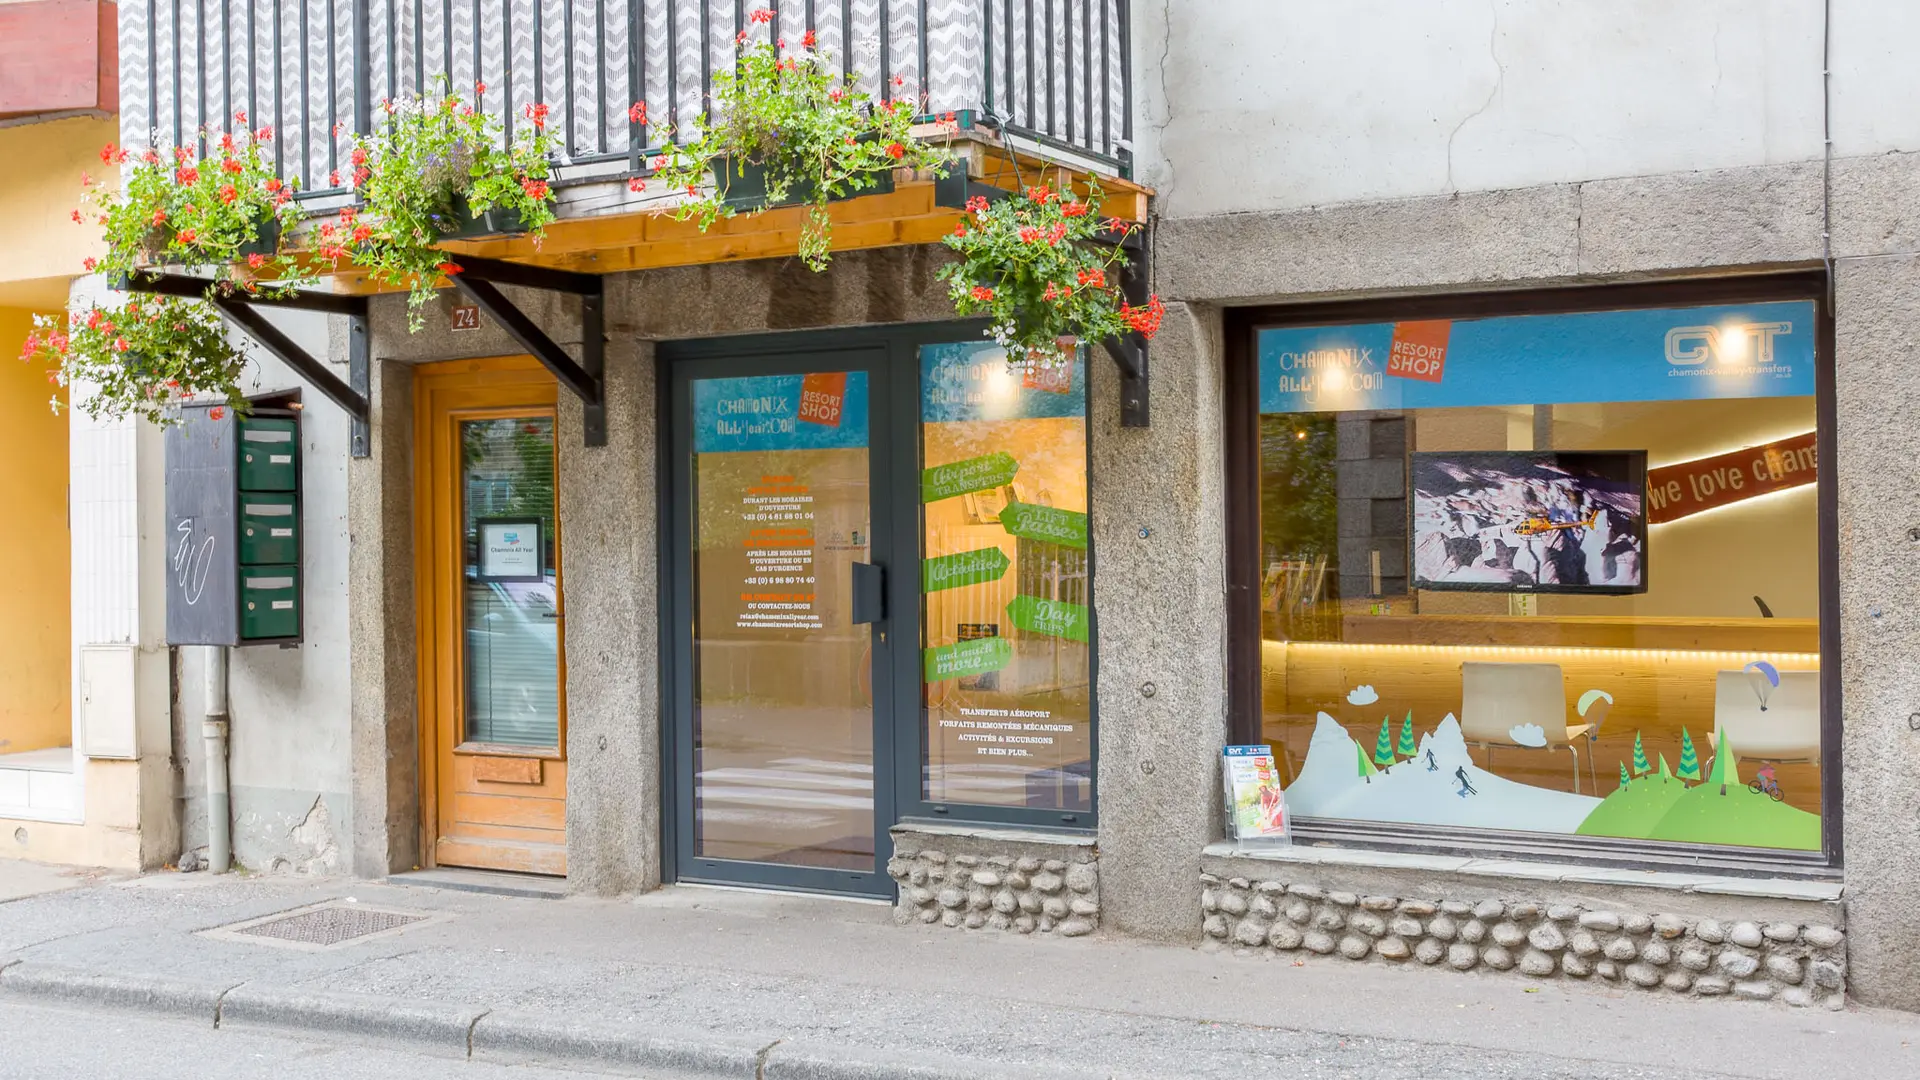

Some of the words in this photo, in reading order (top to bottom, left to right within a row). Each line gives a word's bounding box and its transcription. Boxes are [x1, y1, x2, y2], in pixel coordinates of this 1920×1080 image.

[456, 308, 475, 327] 74
[1280, 347, 1373, 371] CHAMONIX
[1394, 341, 1444, 360] RESORT
[1390, 357, 1440, 376] SHOP
[717, 396, 789, 416] CHAMONIX
[803, 390, 840, 407] RESORT
[801, 402, 839, 421] SHOP
[936, 473, 1005, 497] TRANSFERS
[1648, 480, 1682, 511] we
[1689, 468, 1744, 502] love
[757, 513, 767, 521] (0)
[795, 512, 803, 520] 01
[1034, 508, 1068, 525] LIFT
[757, 576, 769, 585] (0)
[1034, 601, 1077, 627] Day
[1033, 618, 1065, 635] TRIPS
[960, 708, 1009, 717] TRANSFERTS
[1009, 708, 1050, 718] AÉROPORT
[939, 719, 975, 728] FORFAITS
[976, 720, 1022, 730] REMONTÉES
[1023, 721, 1073, 732] MÉCANIQUES
[958, 733, 997, 742] ACTIVITÉS
[1005, 735, 1053, 744] EXCURSIONS
[988, 748, 1007, 756] BIEN
